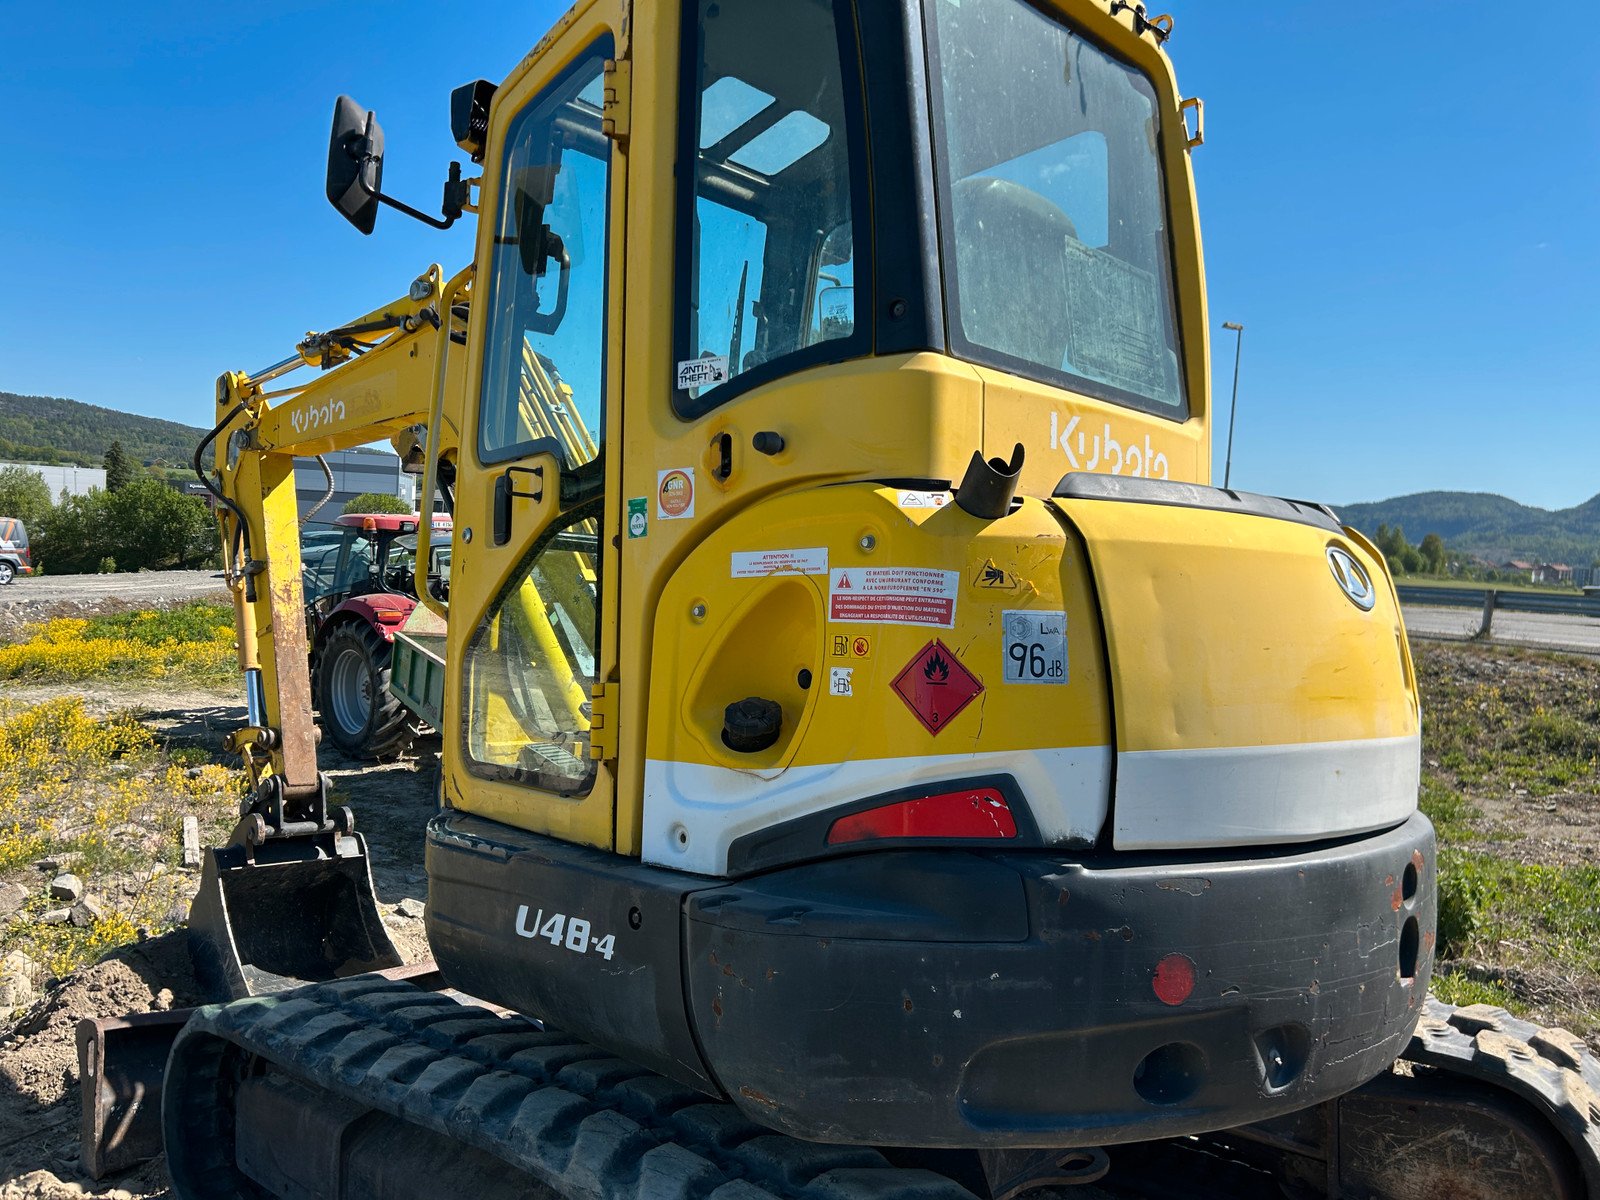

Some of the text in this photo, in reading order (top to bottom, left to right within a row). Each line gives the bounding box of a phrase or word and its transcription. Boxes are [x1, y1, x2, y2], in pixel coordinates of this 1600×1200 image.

[679, 372, 708, 383] THEFT
[680, 365, 704, 375] ANTI
[291, 398, 346, 434] Kubota
[1050, 411, 1169, 481] Kubota
[905, 570, 945, 578] FONCTIONNER
[1009, 642, 1063, 678] 96 dB
[932, 712, 939, 723] 3
[515, 904, 616, 961] U48-4
